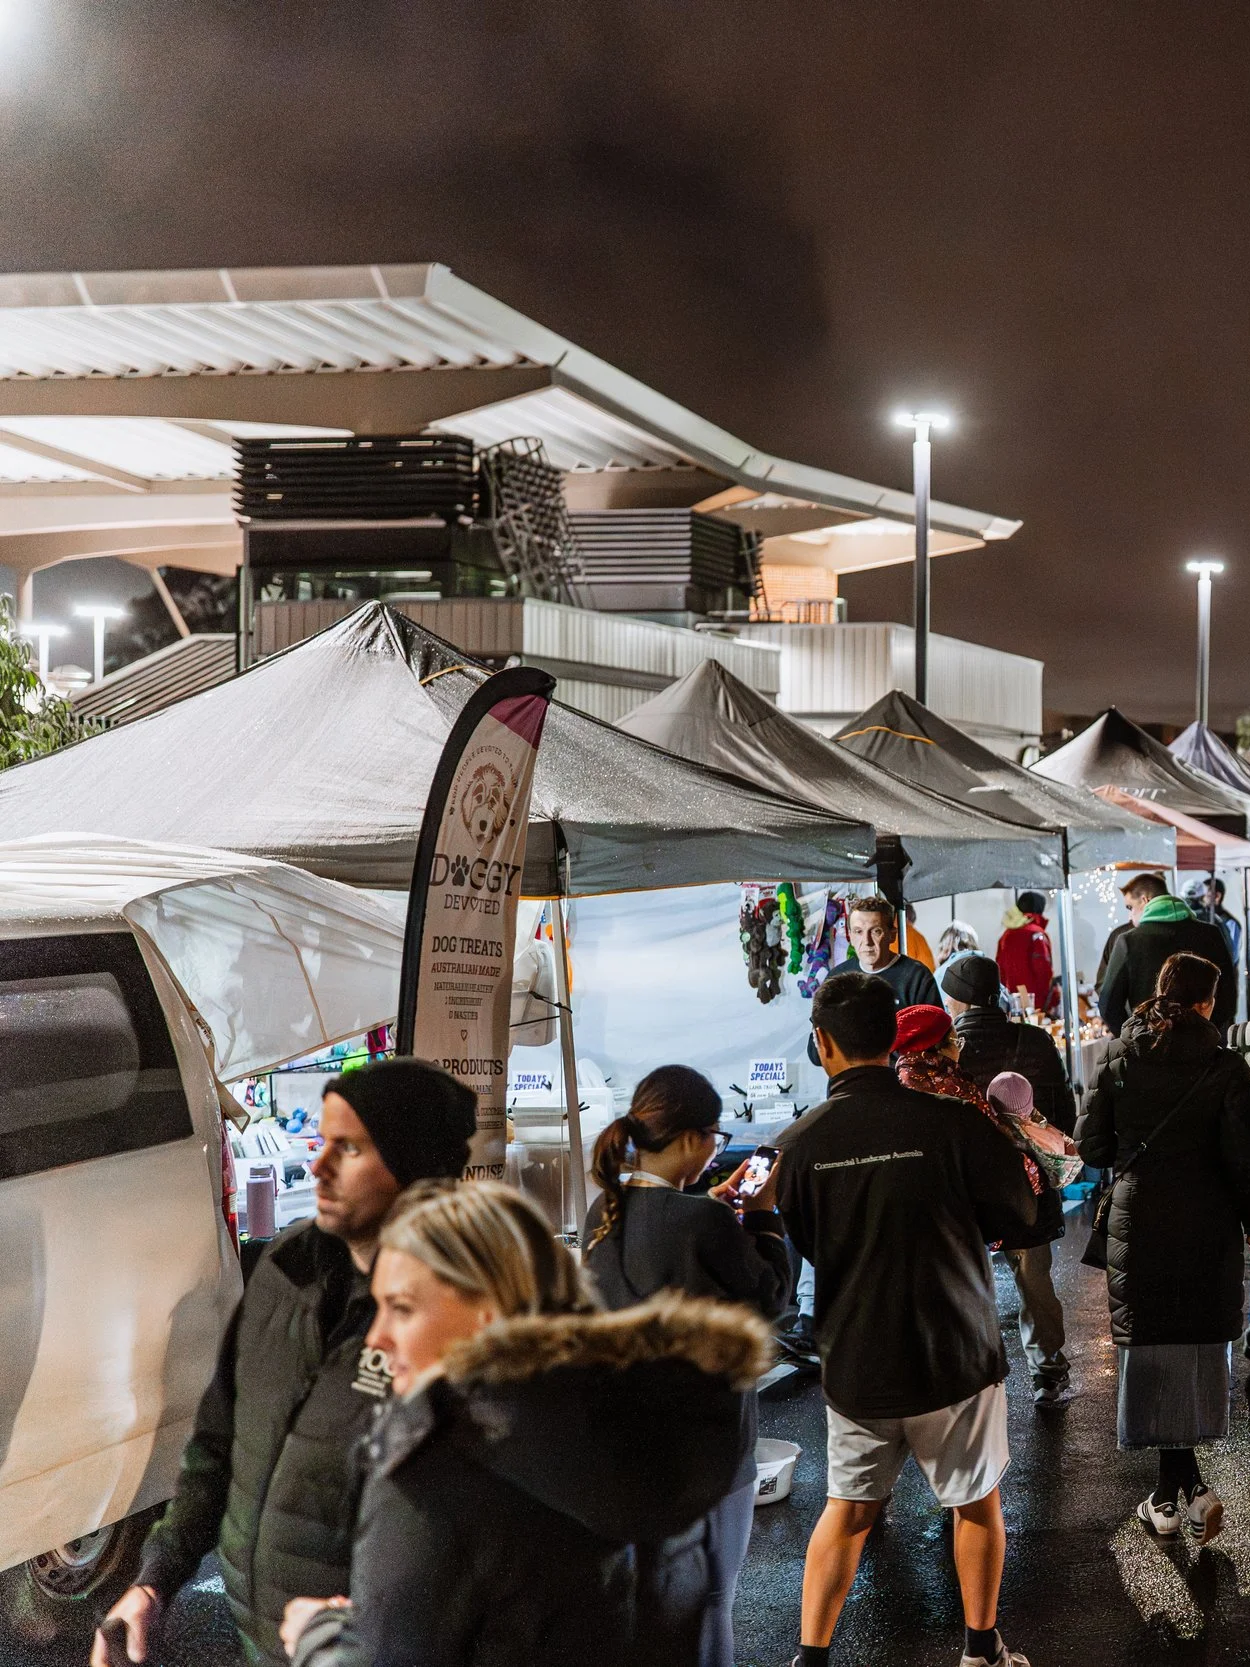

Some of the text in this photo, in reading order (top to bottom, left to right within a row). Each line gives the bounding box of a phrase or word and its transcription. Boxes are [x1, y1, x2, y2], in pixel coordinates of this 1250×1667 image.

[443, 893, 501, 915] DEVOTED
[431, 935, 503, 957] DOG TREATS
[431, 962, 501, 977] AUSTRALIAN MADE
[443, 1058, 504, 1076] PRODUCTS
[754, 1062, 783, 1072] TODAYS
[517, 1074, 547, 1083] TODAYS
[750, 1071, 785, 1081] SPECIALS
[514, 1083, 544, 1091] SPECIA
